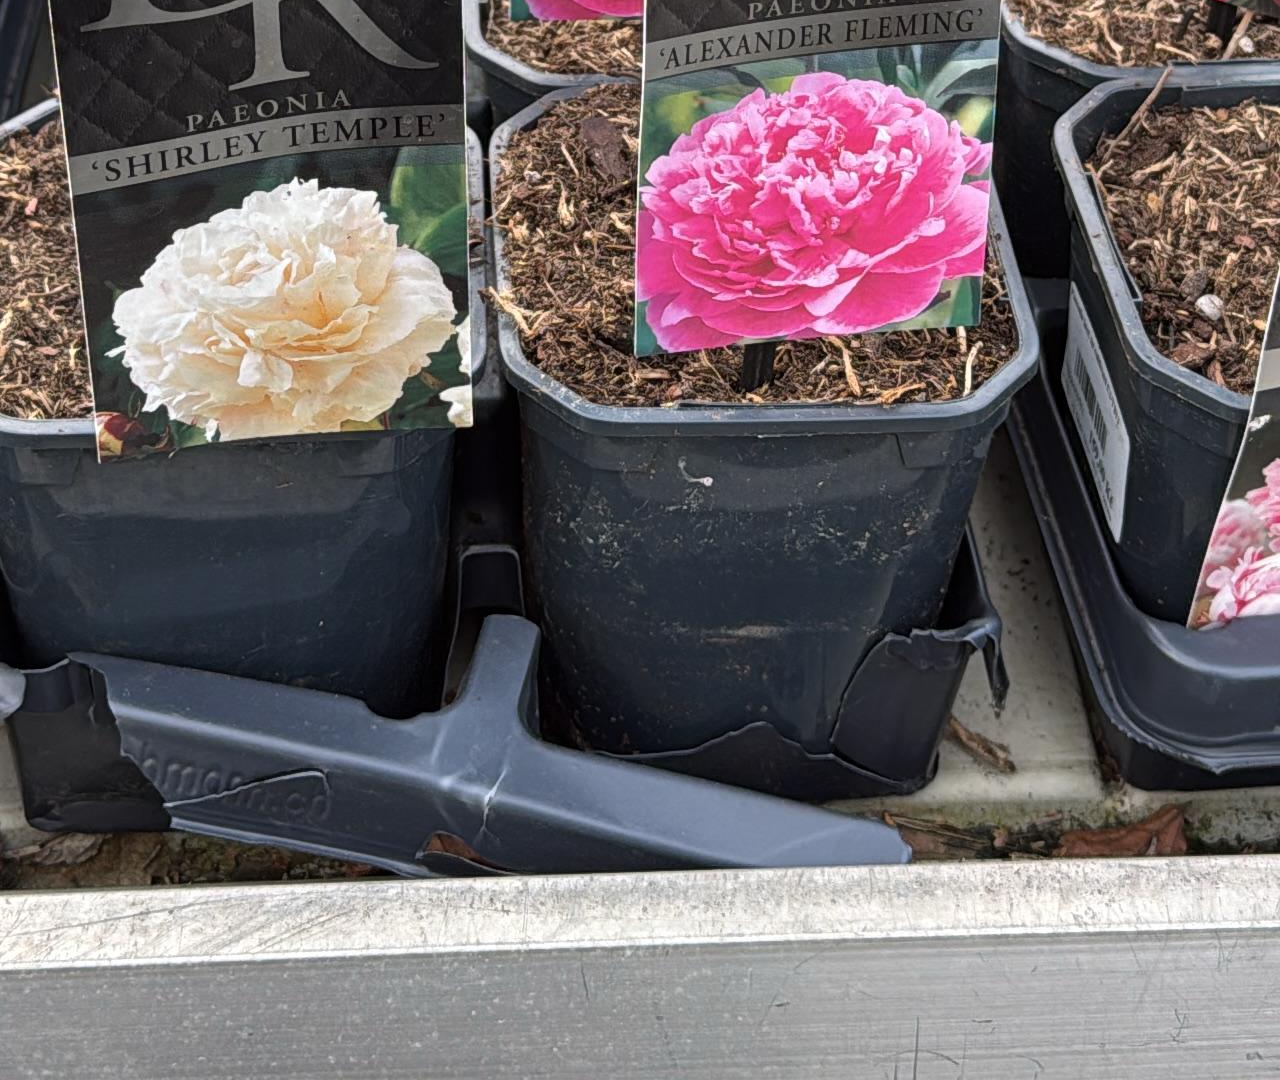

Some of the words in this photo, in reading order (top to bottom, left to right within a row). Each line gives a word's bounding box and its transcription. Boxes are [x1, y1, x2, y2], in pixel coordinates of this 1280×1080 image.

[659, 22, 833, 71] 'ALEXANDER
[844, 7, 984, 42] FLEMING'
[186, 88, 352, 134] PAEONIA
[91, 128, 268, 183] 'SHIRLEY
[282, 113, 447, 149] TEMPLE'
